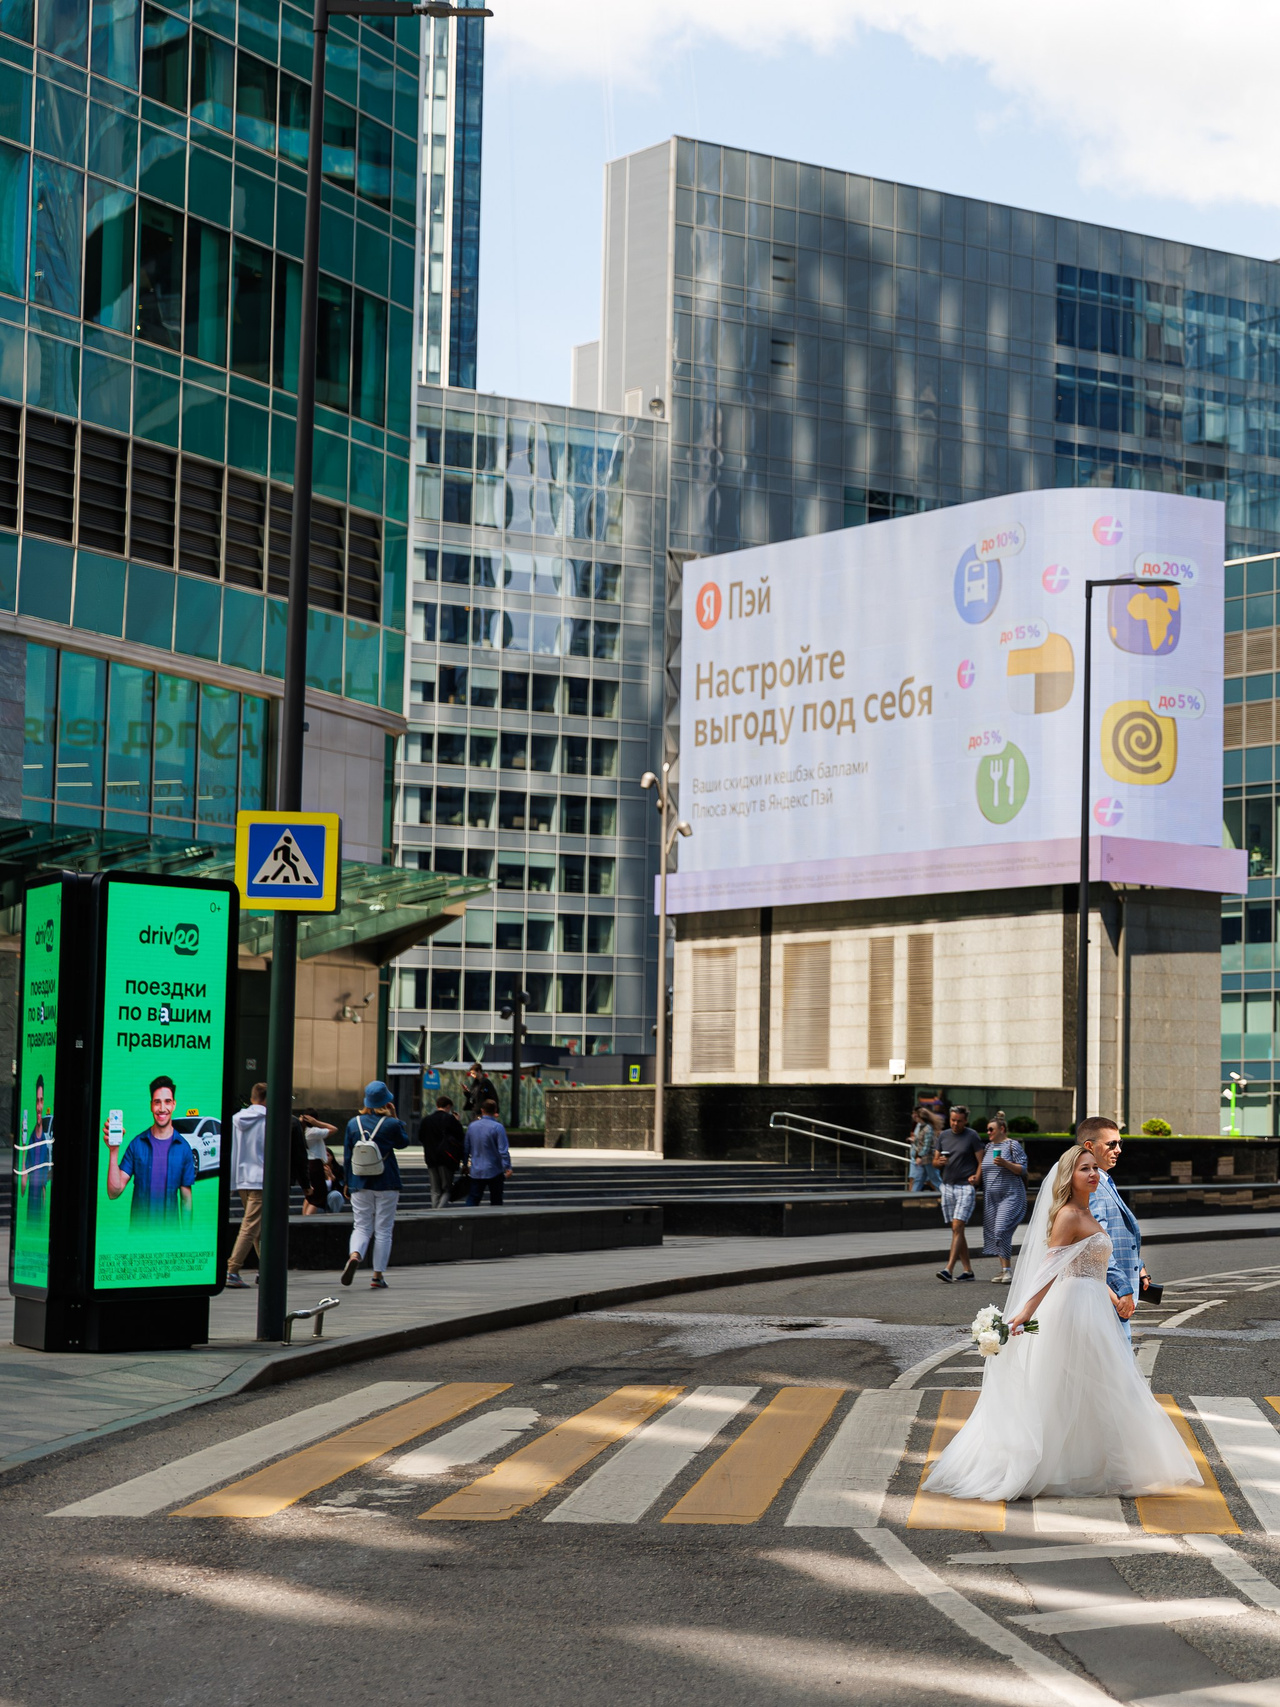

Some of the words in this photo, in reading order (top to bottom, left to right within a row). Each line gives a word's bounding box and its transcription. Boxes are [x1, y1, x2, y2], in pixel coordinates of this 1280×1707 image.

[981, 538, 995, 553] до
[1142, 562, 1161, 576] до
[729, 575, 771, 620] Пэй
[1000, 630, 1013, 644] до
[695, 644, 845, 701] Настройте
[694, 705, 795, 747] выгоду
[802, 697, 856, 736] под
[863, 676, 933, 724] себя
[1158, 694, 1176, 709] до
[968, 735, 982, 750] до
[692, 777, 721, 795] Ваши
[723, 774, 762, 791] скидки
[764, 774, 771, 786] и
[774, 764, 815, 784] кешбэк
[817, 761, 869, 780] баллами
[692, 803, 727, 820] Плюса
[729, 800, 757, 818] ждут
[760, 799, 766, 812] в
[768, 793, 808, 811] Яндекс
[811, 787, 834, 806] Пэй
[209, 902, 221, 913] 0+
[138, 923, 199, 955] drivee
[125, 979, 207, 1000] поездки
[118, 1006, 142, 1021] по
[147, 1005, 211, 1025] вашим
[117, 1031, 211, 1052] правилам
